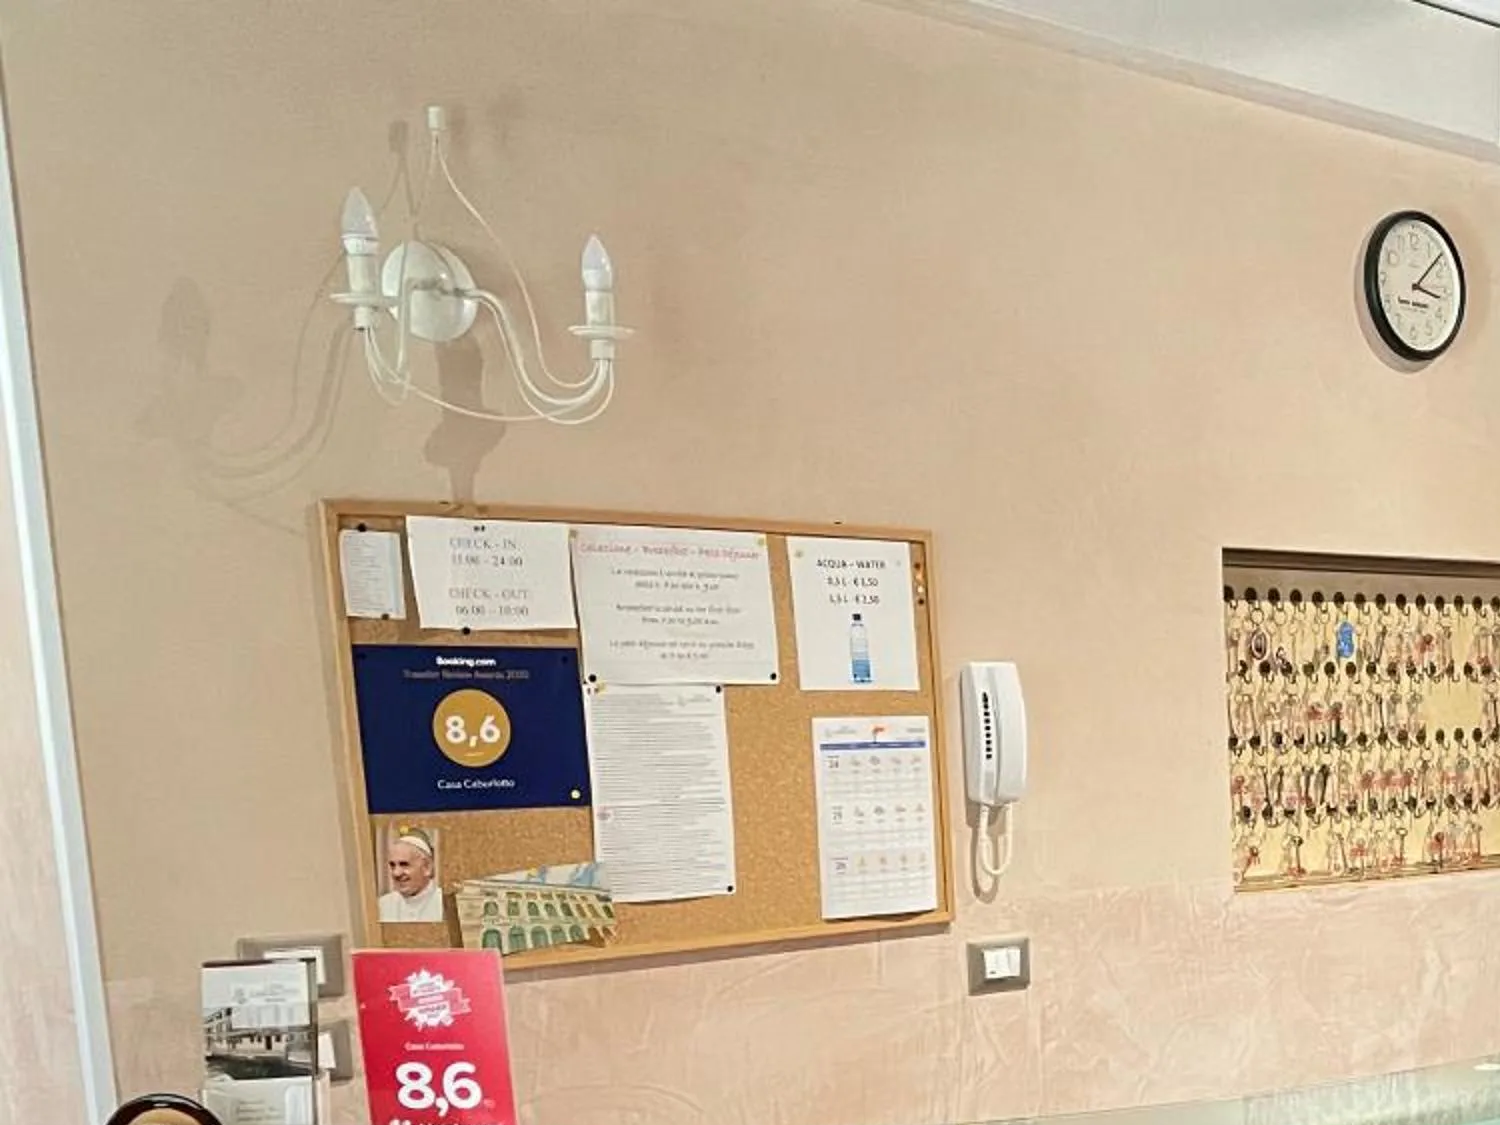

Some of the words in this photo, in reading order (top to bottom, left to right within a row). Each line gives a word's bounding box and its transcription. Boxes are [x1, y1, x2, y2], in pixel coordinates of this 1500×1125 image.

[436, 655, 497, 667] Booking.com
[445, 715, 501, 748] 8,6
[437, 779, 463, 789] Casa
[395, 1061, 482, 1117] 8,6
